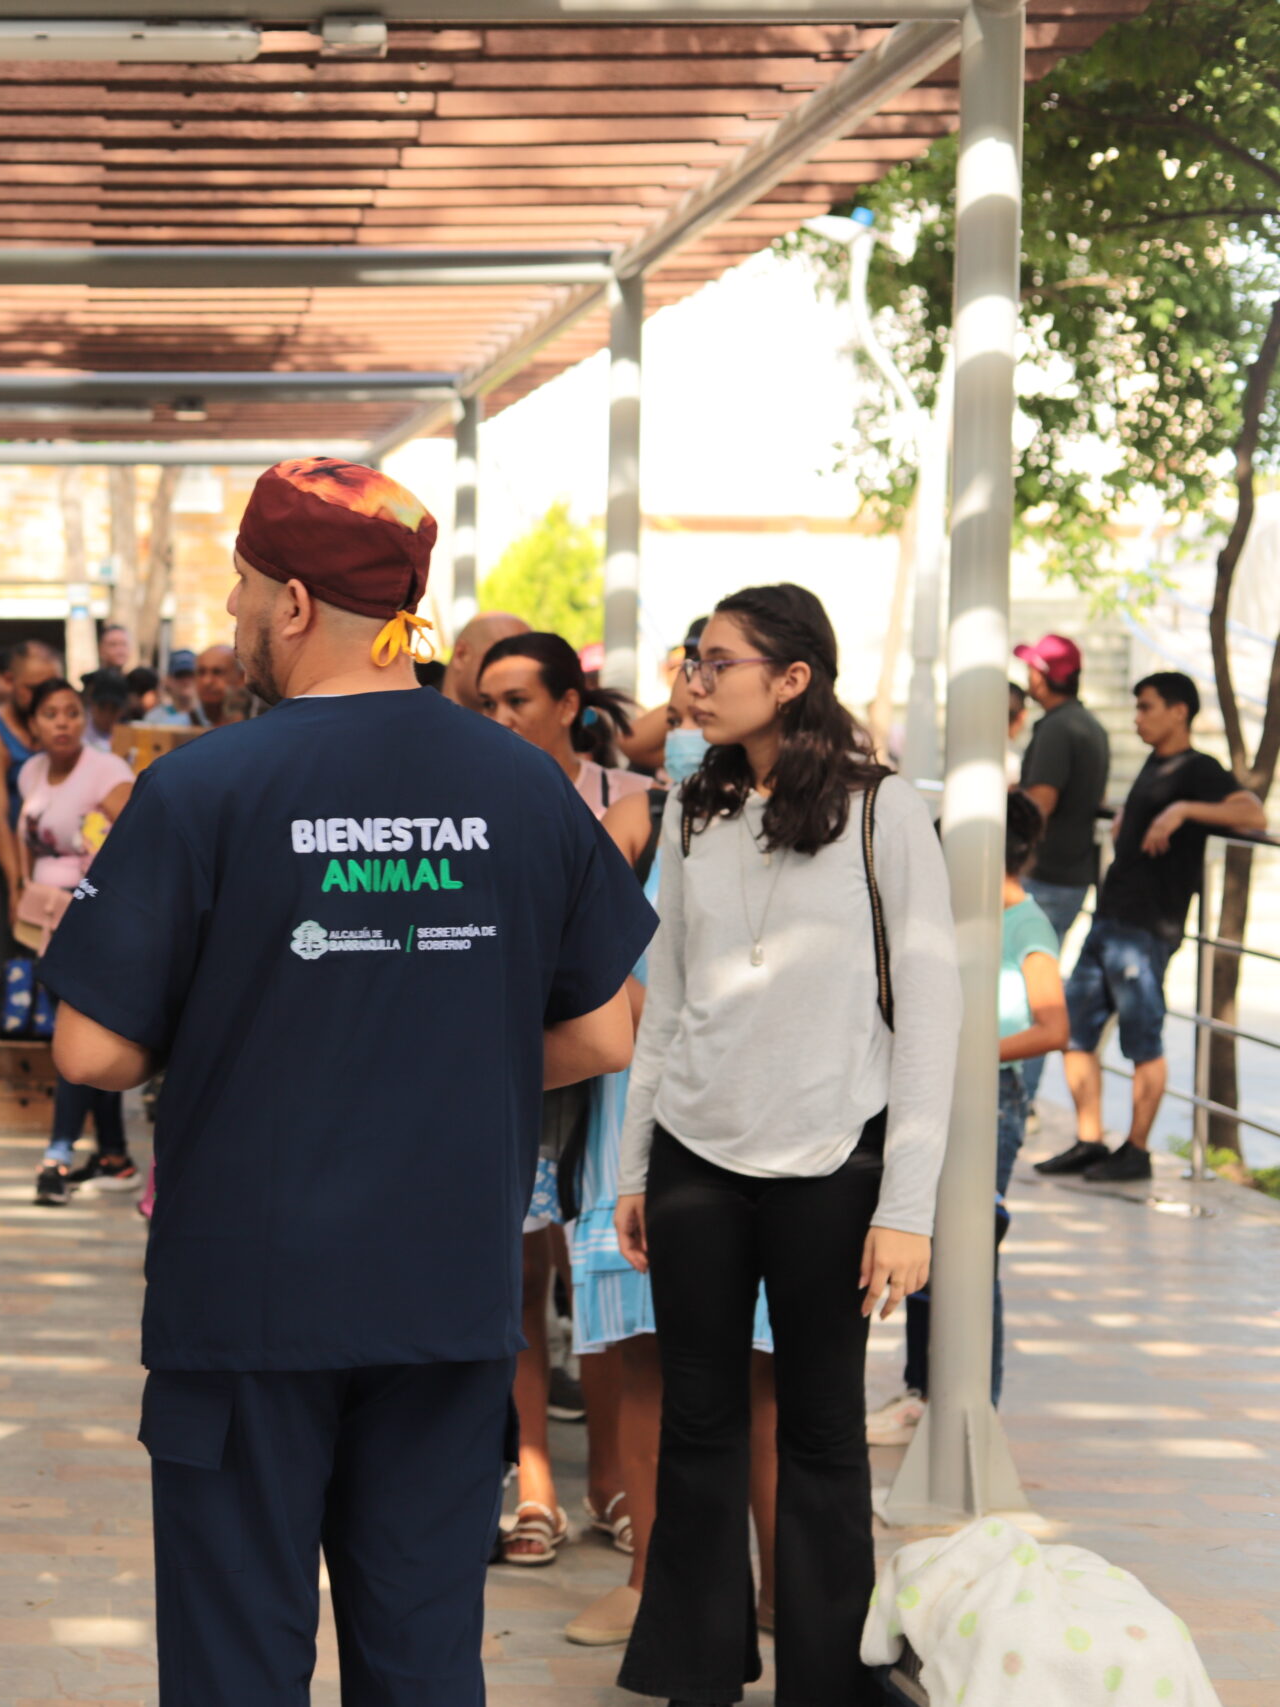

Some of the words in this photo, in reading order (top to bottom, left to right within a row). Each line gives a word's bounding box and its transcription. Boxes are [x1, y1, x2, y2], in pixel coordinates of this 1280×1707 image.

[291, 817, 490, 853] BIENESTAR
[321, 858, 464, 892] ANIMAL
[371, 929, 383, 939] DE
[417, 923, 481, 939] SECRETARÍA
[481, 926, 497, 937] DE
[417, 939, 471, 951] GOBIERNO
